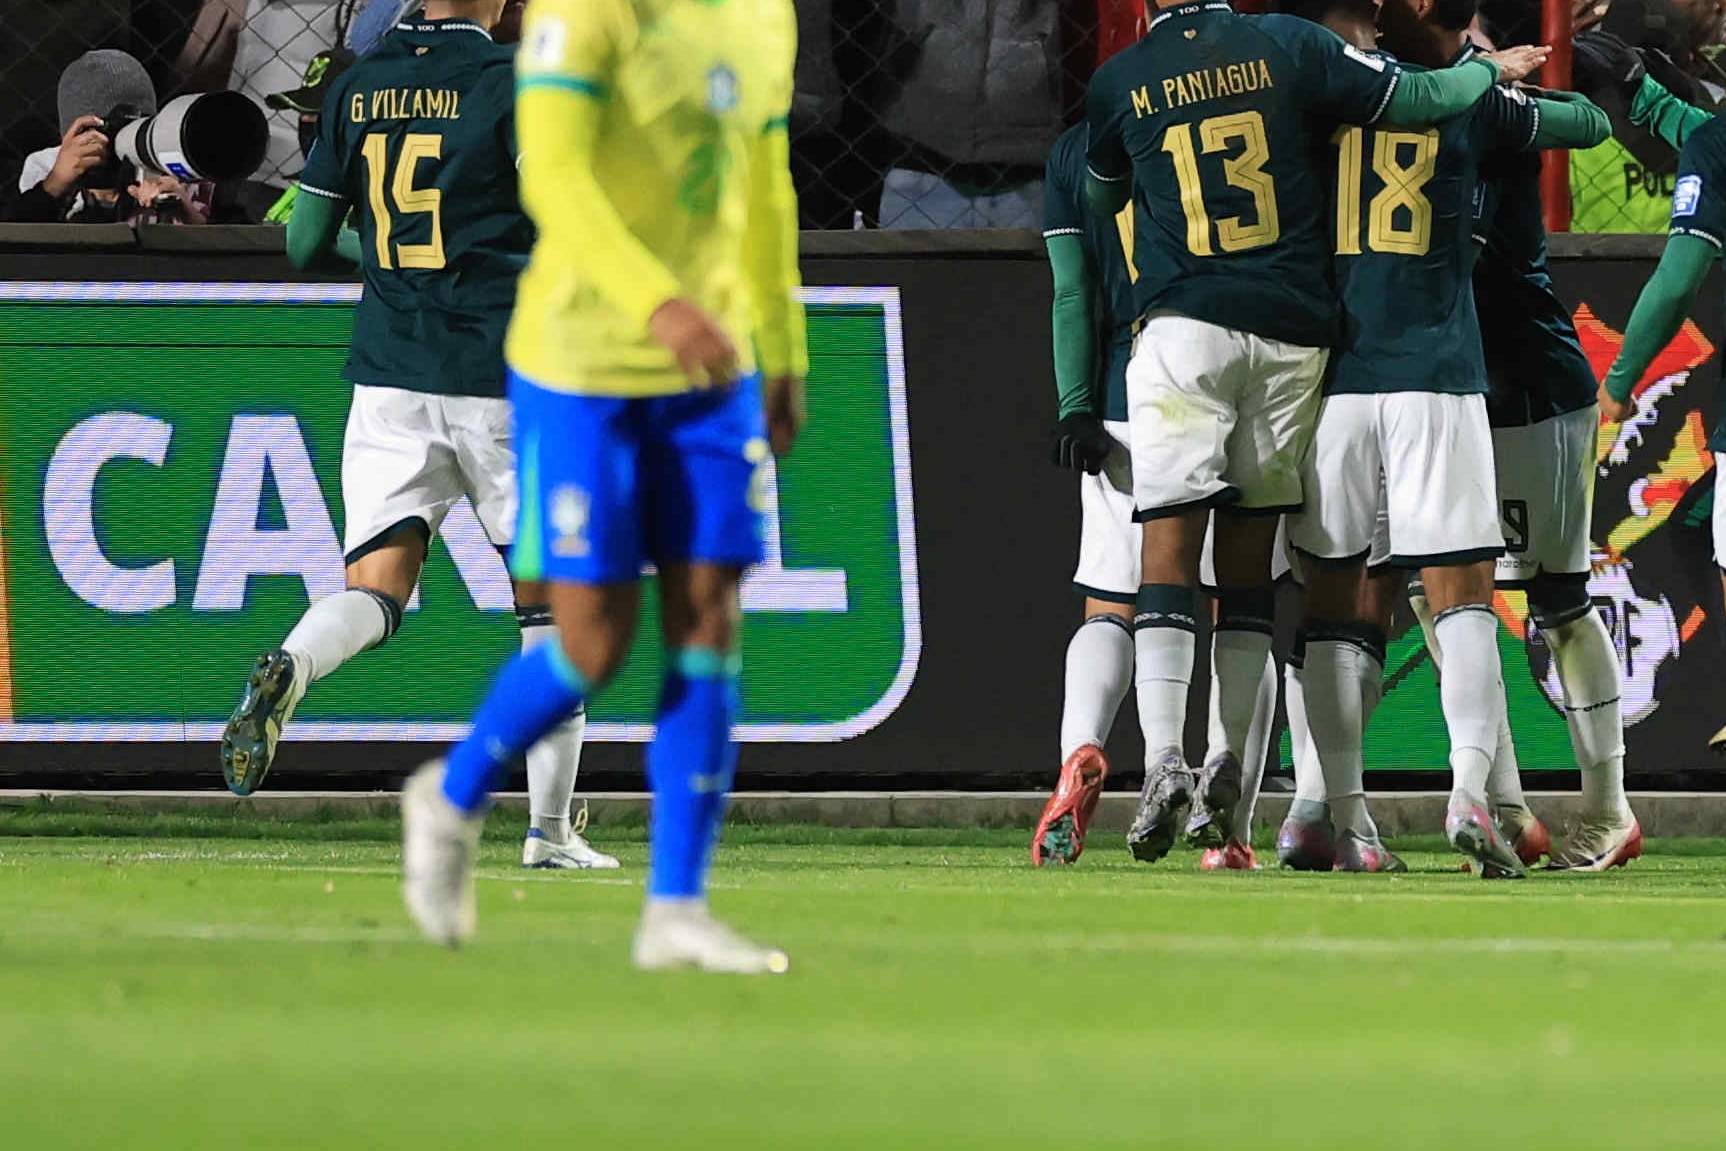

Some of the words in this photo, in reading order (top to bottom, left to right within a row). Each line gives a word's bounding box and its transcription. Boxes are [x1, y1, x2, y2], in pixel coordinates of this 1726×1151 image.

[351, 93, 367, 123] G.
[372, 88, 460, 120] VILLAMIL
[1130, 85, 1159, 119] M.
[1162, 58, 1273, 109] PANIAGUA
[361, 133, 446, 270] 15
[1161, 110, 1280, 256] 13
[1330, 124, 1440, 256] 18
[1623, 162, 1676, 202] POL
[42, 410, 848, 614] CAL
